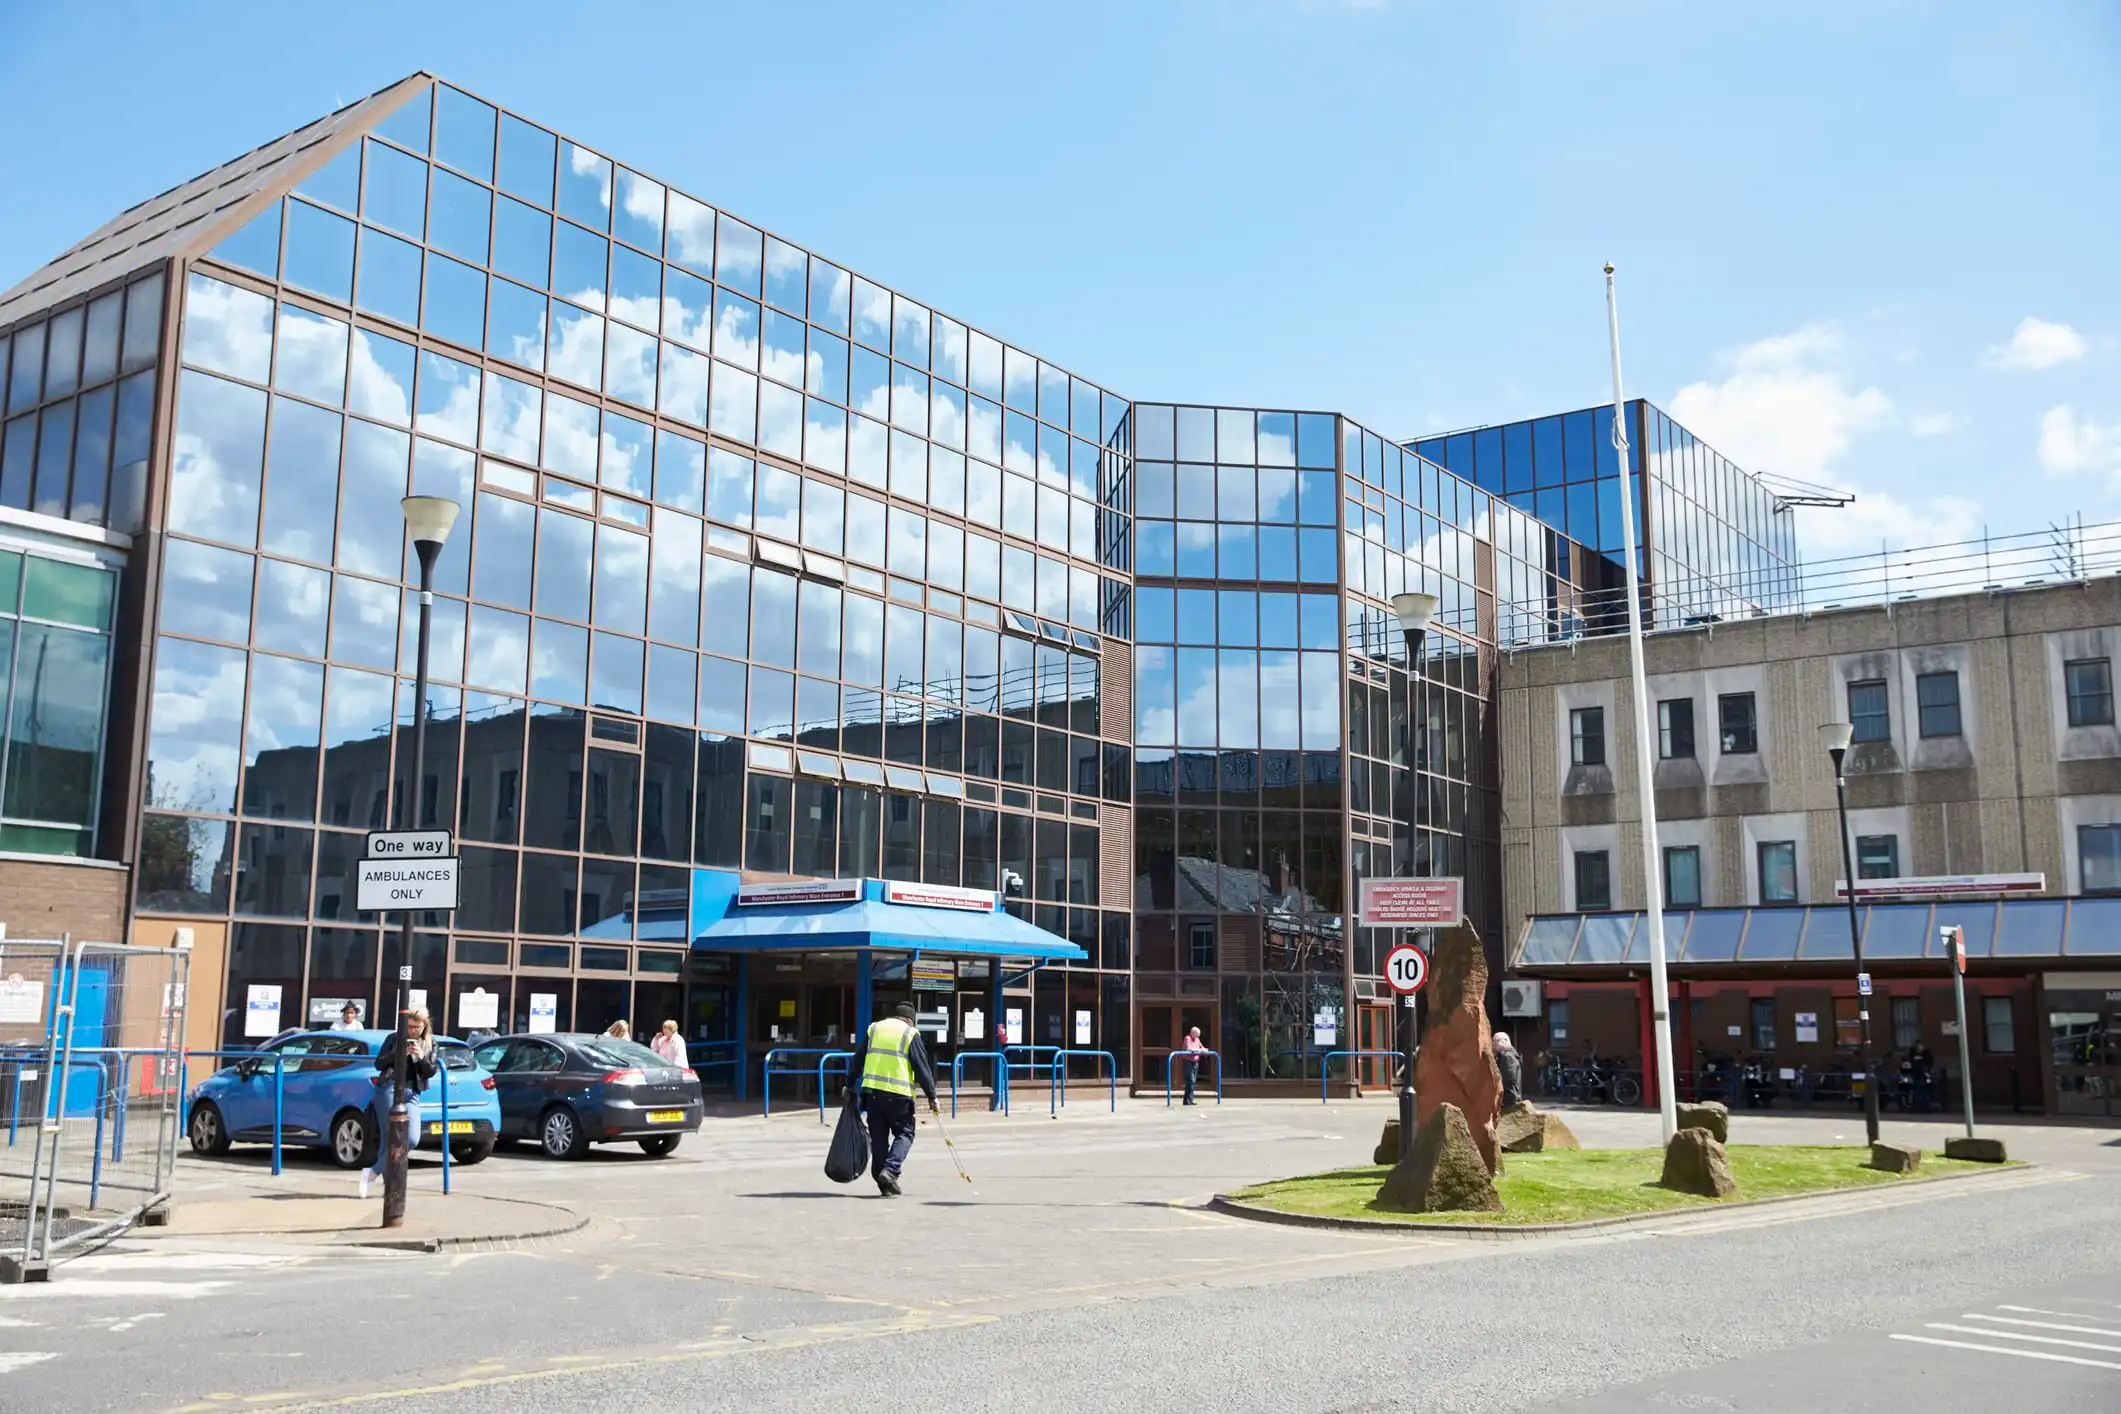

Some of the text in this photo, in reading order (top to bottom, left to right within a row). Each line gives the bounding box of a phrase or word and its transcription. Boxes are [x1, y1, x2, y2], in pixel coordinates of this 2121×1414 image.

[375, 839, 443, 853] One way
[365, 870, 450, 881] AMBULANCES
[391, 889, 423, 899] ONLY
[1393, 958, 1418, 980] 10
